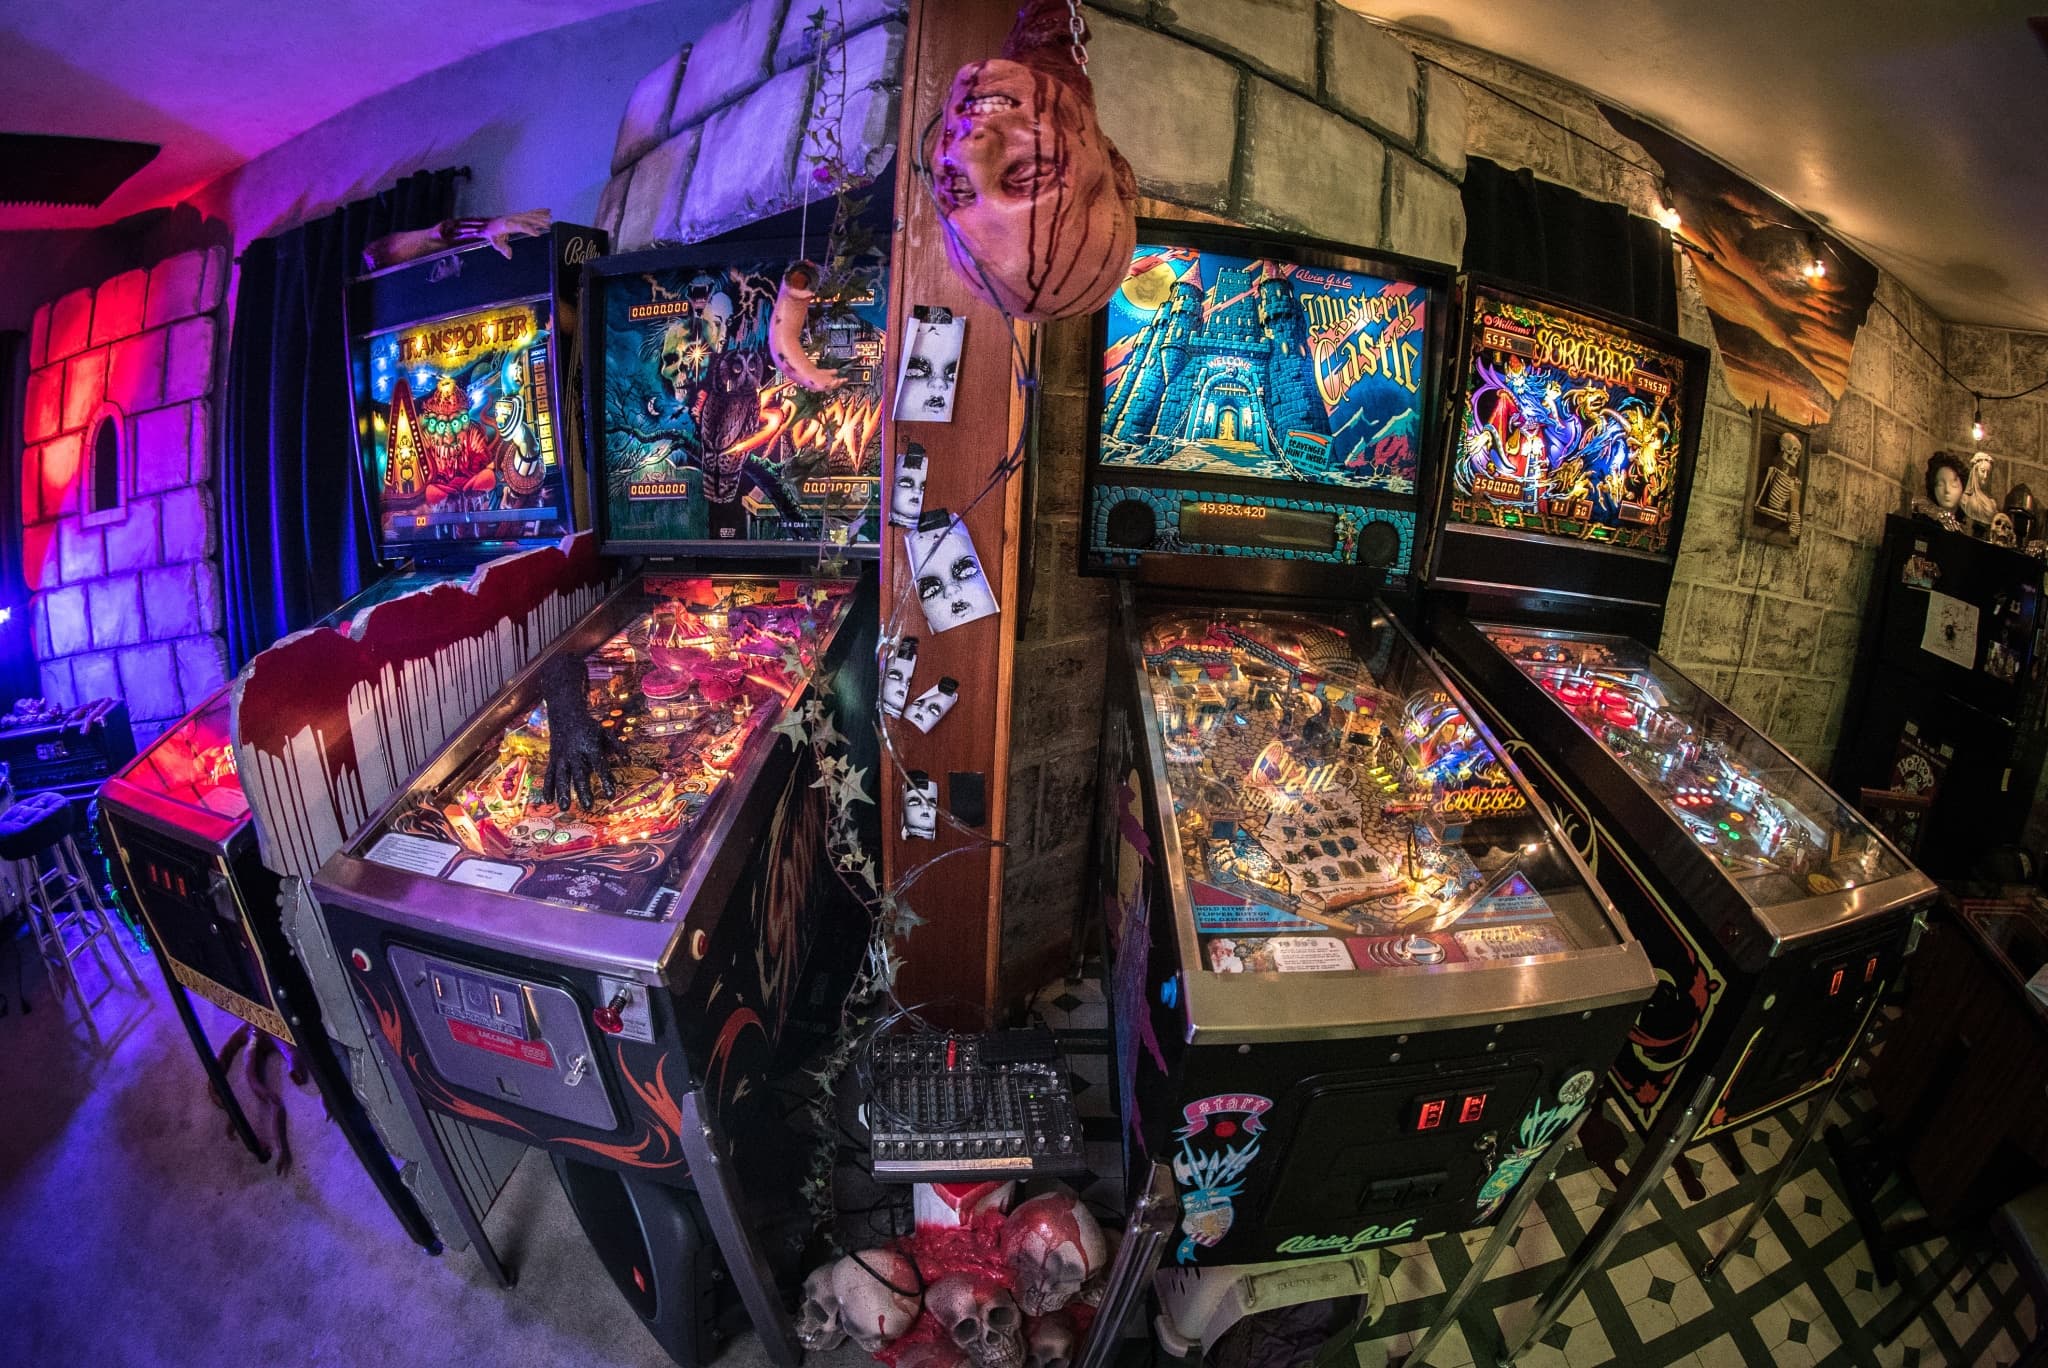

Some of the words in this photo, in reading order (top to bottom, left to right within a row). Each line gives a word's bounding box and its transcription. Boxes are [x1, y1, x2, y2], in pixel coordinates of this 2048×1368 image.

[1296, 269, 1324, 285] Alvin
[1300, 288, 1416, 343] Mystery
[1492, 316, 1531, 336] Williams
[398, 314, 529, 361] TRANSPORTER
[1206, 355, 1253, 372] WELCOME
[1313, 330, 1421, 407] Castle
[1532, 328, 1637, 392] SORCERER
[1284, 448, 1304, 461] HUNT
[1306, 452, 1328, 466] INSIDE
[1288, 439, 1327, 459] SCAVENGER
[1276, 1234, 1350, 1253] Alvin
